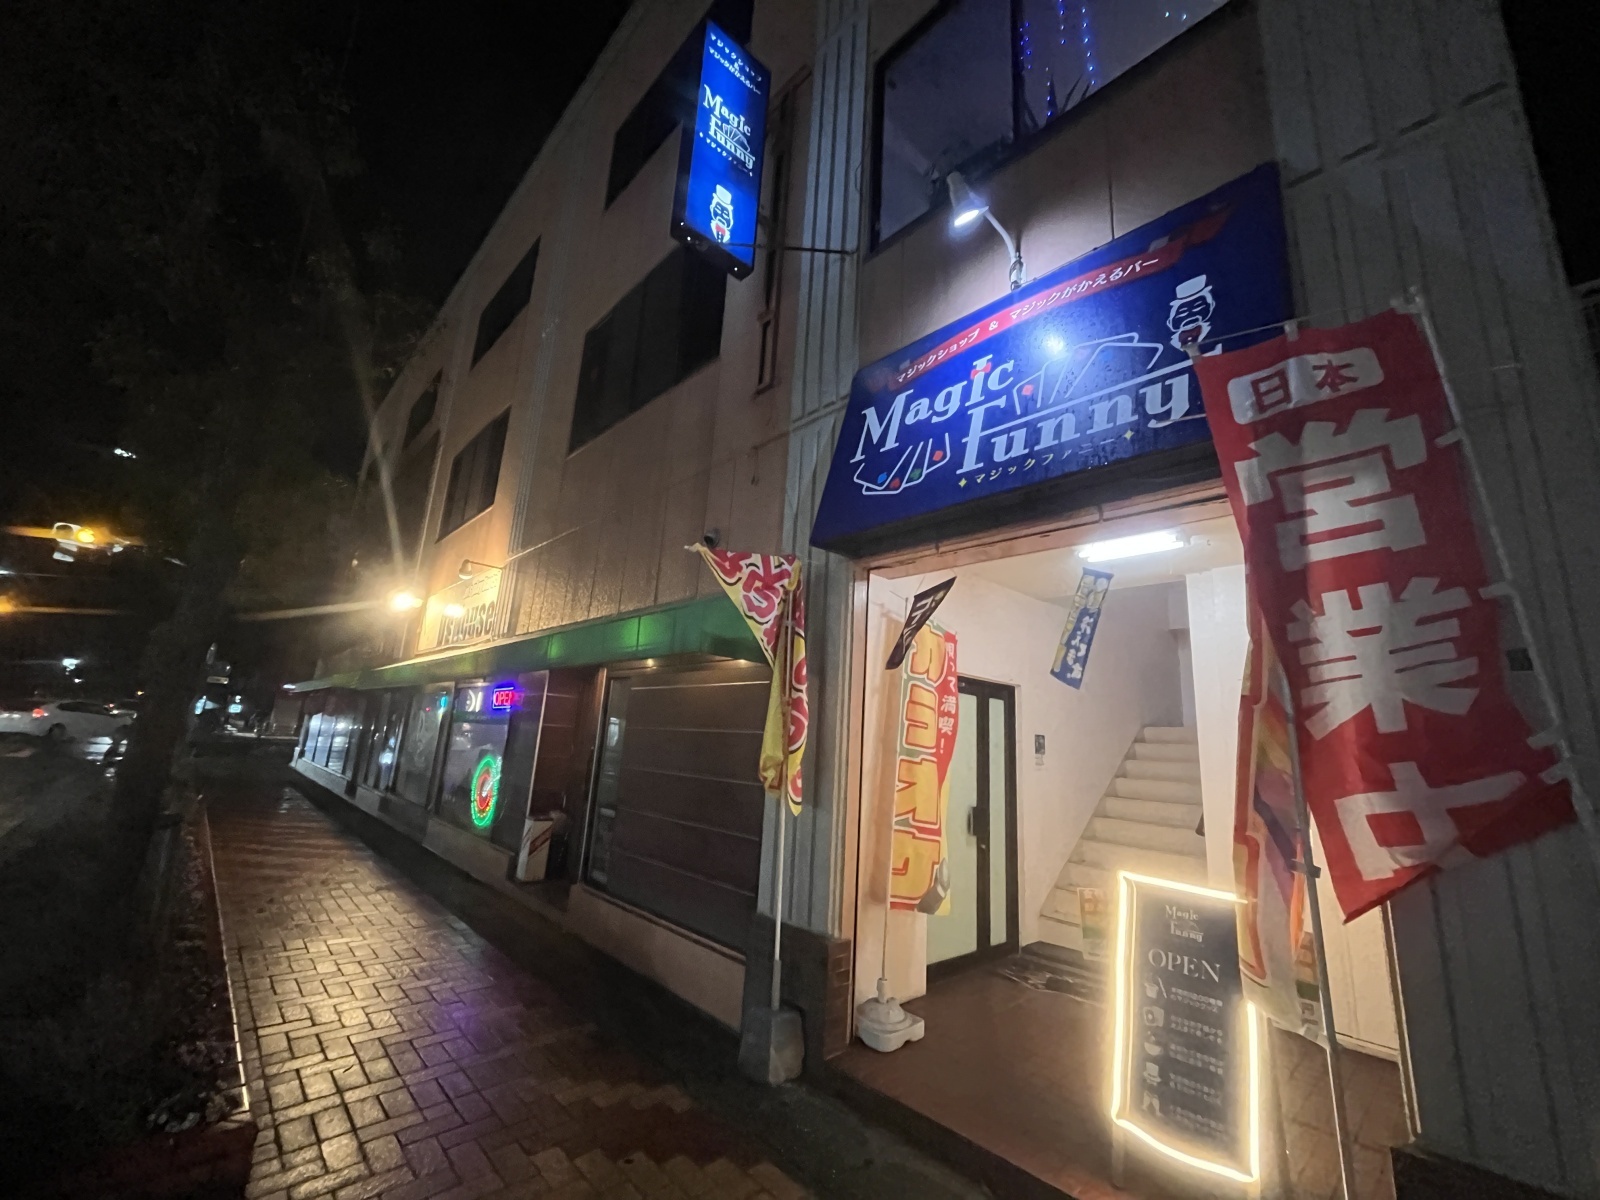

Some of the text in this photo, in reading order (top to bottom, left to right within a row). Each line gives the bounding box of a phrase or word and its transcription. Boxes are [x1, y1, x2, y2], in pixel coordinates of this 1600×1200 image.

[708, 114, 756, 170] Funny
[896, 258, 1160, 383] マジックショップ & マジックがかえるバー
[850, 354, 1014, 464] Magic
[956, 372, 1192, 475] Funny
[974, 437, 1118, 484] マジックファニー
[1148, 948, 1221, 983] OPEN
